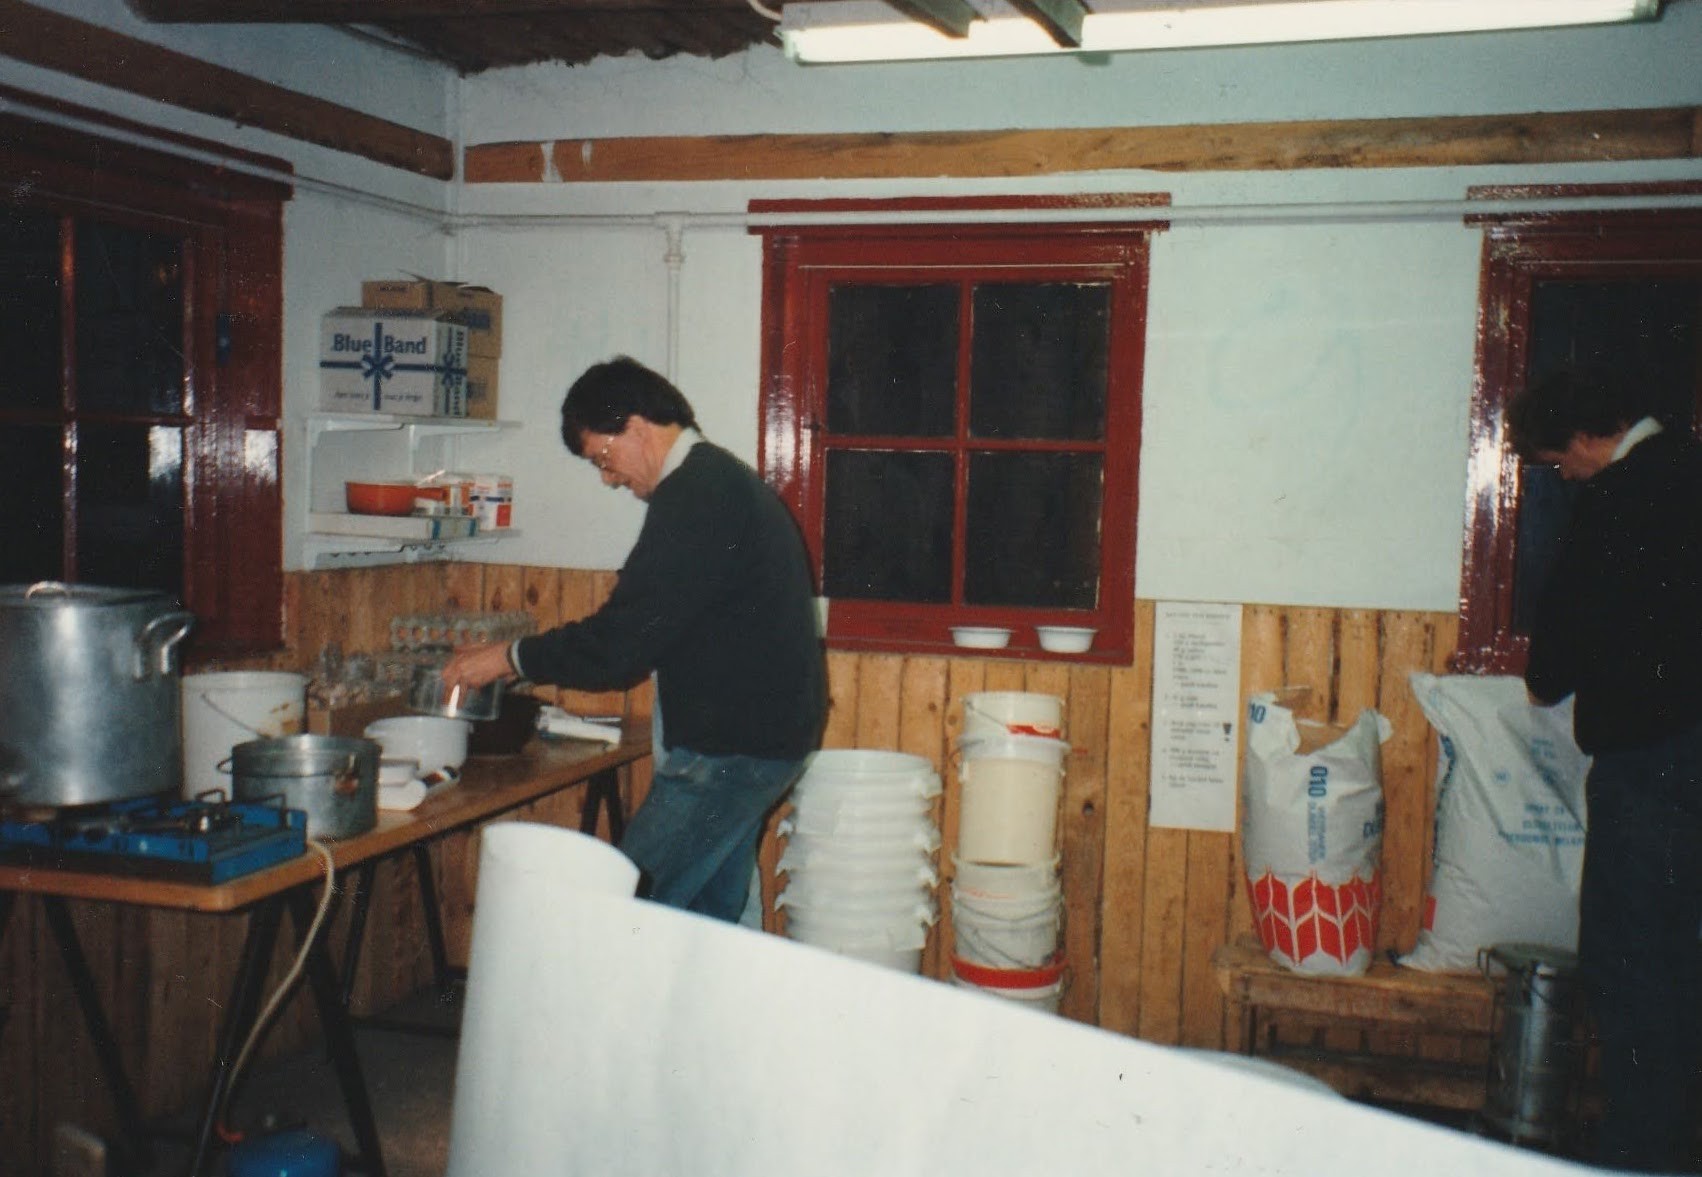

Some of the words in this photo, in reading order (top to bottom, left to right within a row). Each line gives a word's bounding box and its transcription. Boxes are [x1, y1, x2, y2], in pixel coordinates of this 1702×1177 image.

[333, 333, 372, 352] Blue
[384, 335, 427, 354] Band
[1308, 766, 1328, 797] 010
